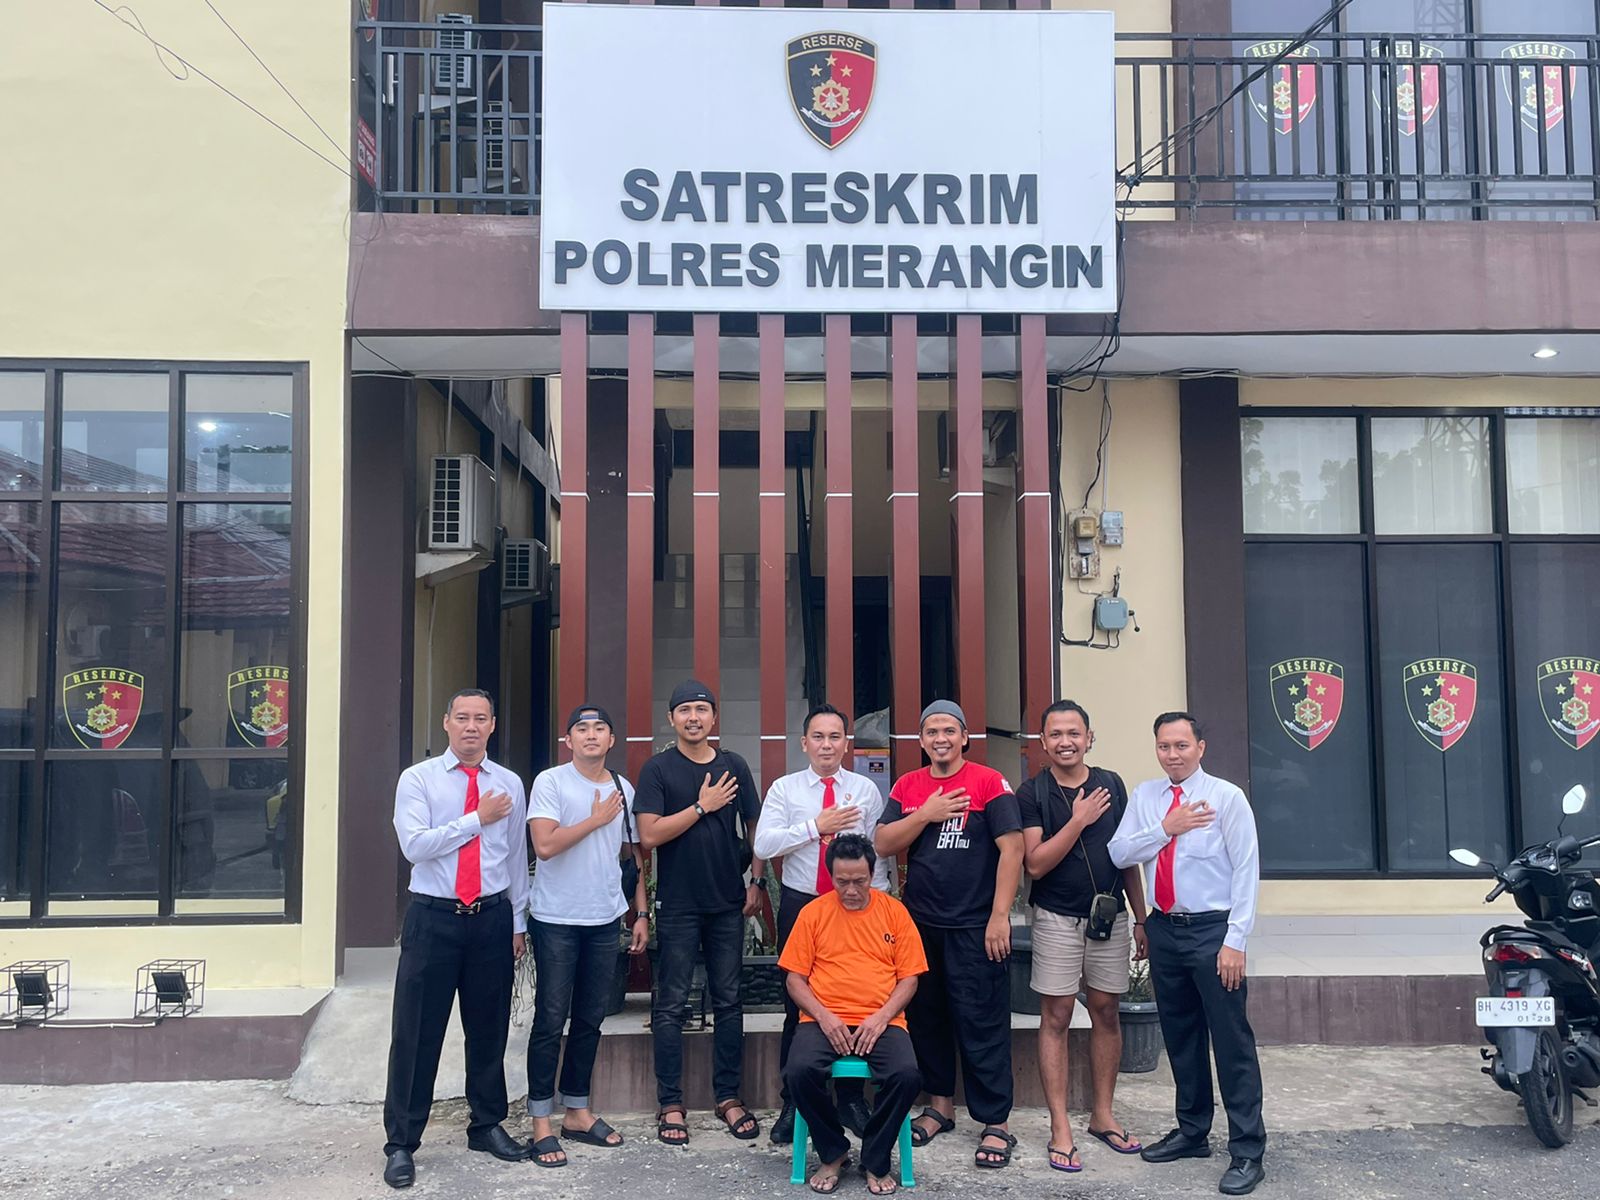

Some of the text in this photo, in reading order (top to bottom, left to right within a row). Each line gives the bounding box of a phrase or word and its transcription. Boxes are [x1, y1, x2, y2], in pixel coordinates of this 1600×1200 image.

[801, 35, 864, 51] RESERSE
[1251, 43, 1310, 57] RESESE
[1509, 44, 1566, 58] RESERSE
[620, 168, 1039, 225] SATRESKRIM
[554, 239, 1104, 289] POLRES MERANGIN
[1278, 660, 1334, 675] RESERSE
[1412, 660, 1467, 675] RESERSE
[1544, 659, 1600, 674] RESERSE
[72, 670, 135, 684] RESERSE
[1478, 1000, 1551, 1012] BH 4319 XG
